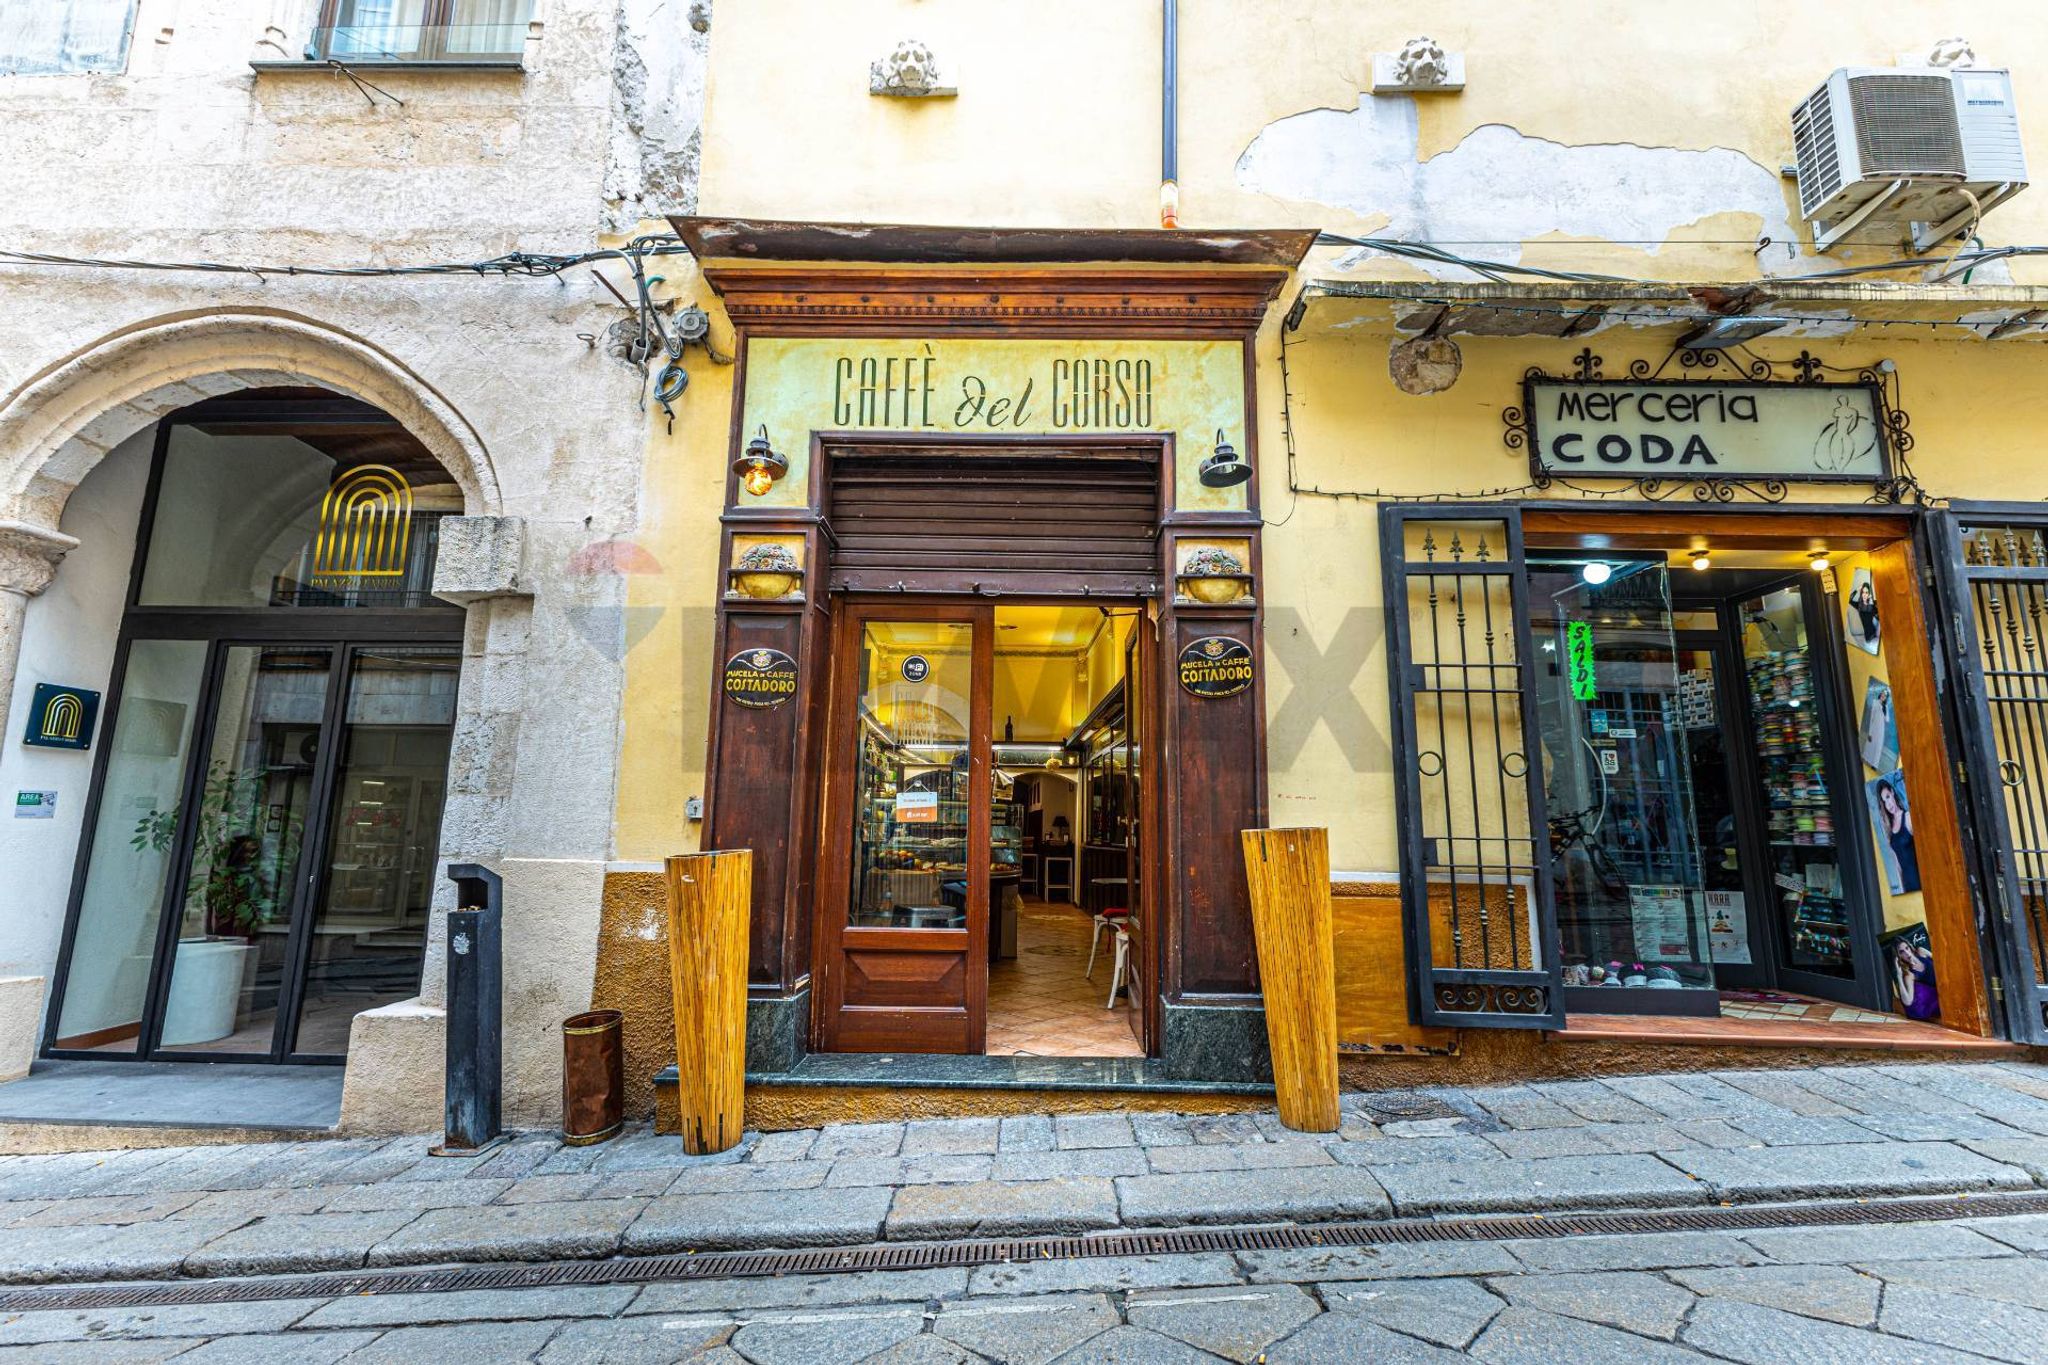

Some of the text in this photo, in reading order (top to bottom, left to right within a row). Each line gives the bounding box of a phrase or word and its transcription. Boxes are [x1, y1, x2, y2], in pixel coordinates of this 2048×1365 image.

[833, 343, 1152, 428] CAFFÈ del CORSO
[1556, 389, 1759, 423] Merceria
[1551, 432, 1719, 465] CODA
[1181, 666, 1253, 684] COSTADORO
[1573, 625, 1589, 697] SALDI
[726, 678, 796, 693] COSTADORO
